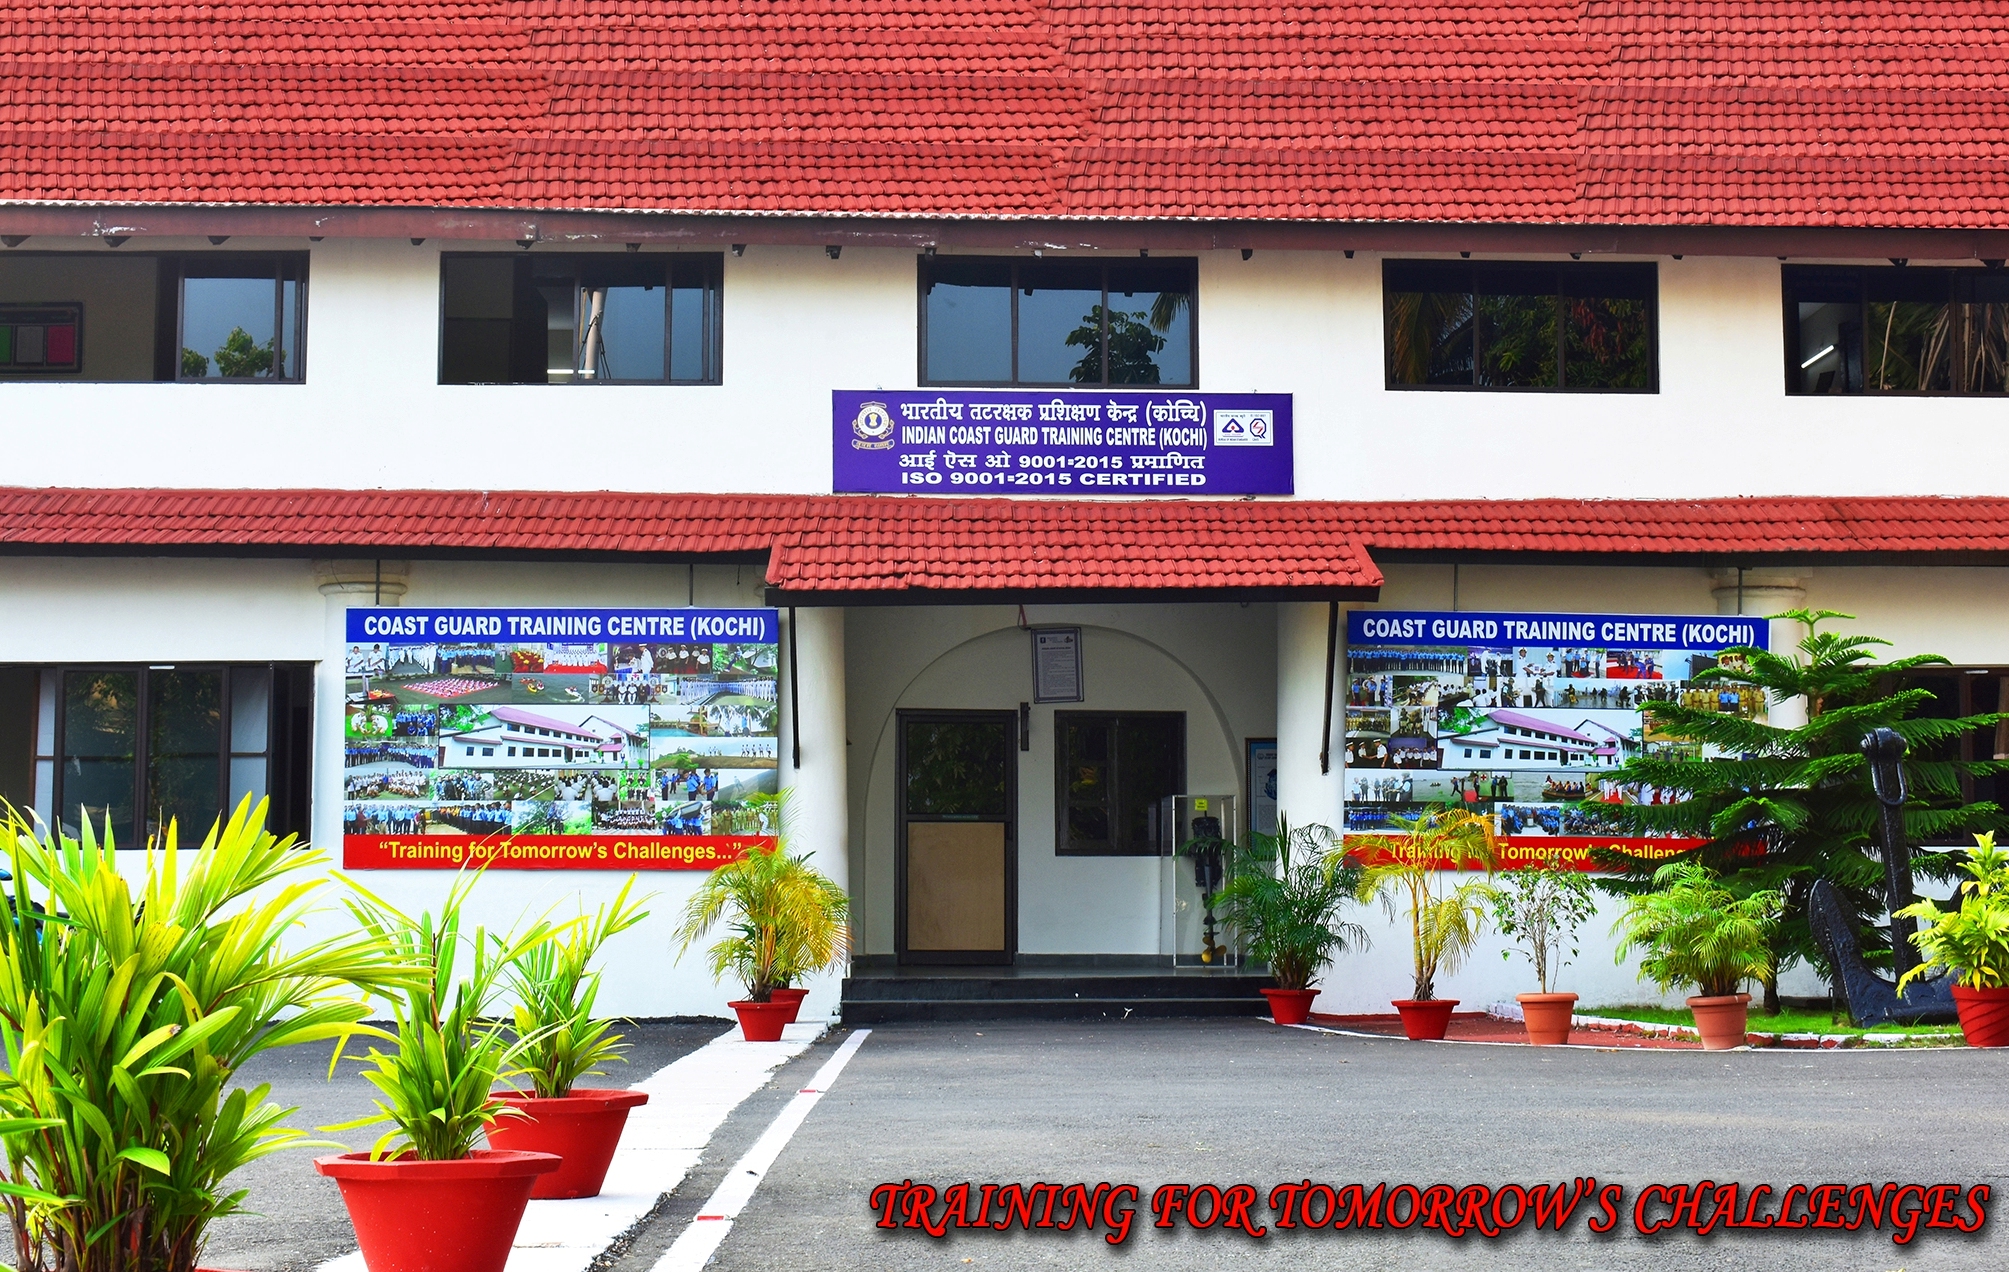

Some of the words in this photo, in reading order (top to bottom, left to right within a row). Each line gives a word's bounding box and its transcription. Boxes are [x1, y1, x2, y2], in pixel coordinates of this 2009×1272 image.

[901, 397, 964, 420] भारतीय
[969, 403, 1033, 421] तटरक्षक
[1038, 398, 1101, 422] प्रशिक्षण
[1106, 398, 1139, 423] केन्द्र
[1145, 399, 1207, 426] (कोच्चि)
[902, 426, 945, 444] INDIAN
[949, 426, 991, 445] COAST
[994, 427, 1038, 445] GUARD
[1042, 427, 1102, 445] TRAINING
[1106, 427, 1156, 446] CENTRE
[1159, 427, 1207, 450] (KOCHI)
[899, 450, 937, 470] आई
[985, 450, 1011, 468] ओ
[1130, 452, 1206, 469] प्रमाणित
[901, 472, 942, 485] ISO
[1080, 473, 1206, 486] CERTIFIED
[364, 616, 428, 636] COAST
[434, 616, 502, 636] GUARD
[507, 616, 601, 636] TRAINING
[607, 616, 684, 636] CENTRE
[690, 616, 765, 641] (KOCHI)
[1363, 619, 1427, 638] COAST
[1432, 620, 1498, 639] GUARD
[1503, 621, 1595, 642] TRAINING
[1601, 623, 1676, 643] CENTRE
[1682, 623, 1755, 649] (KOCHI)
[379, 841, 463, 863] “Training
[468, 841, 495, 859] for
[499, 841, 608, 859] Tomorrow’s
